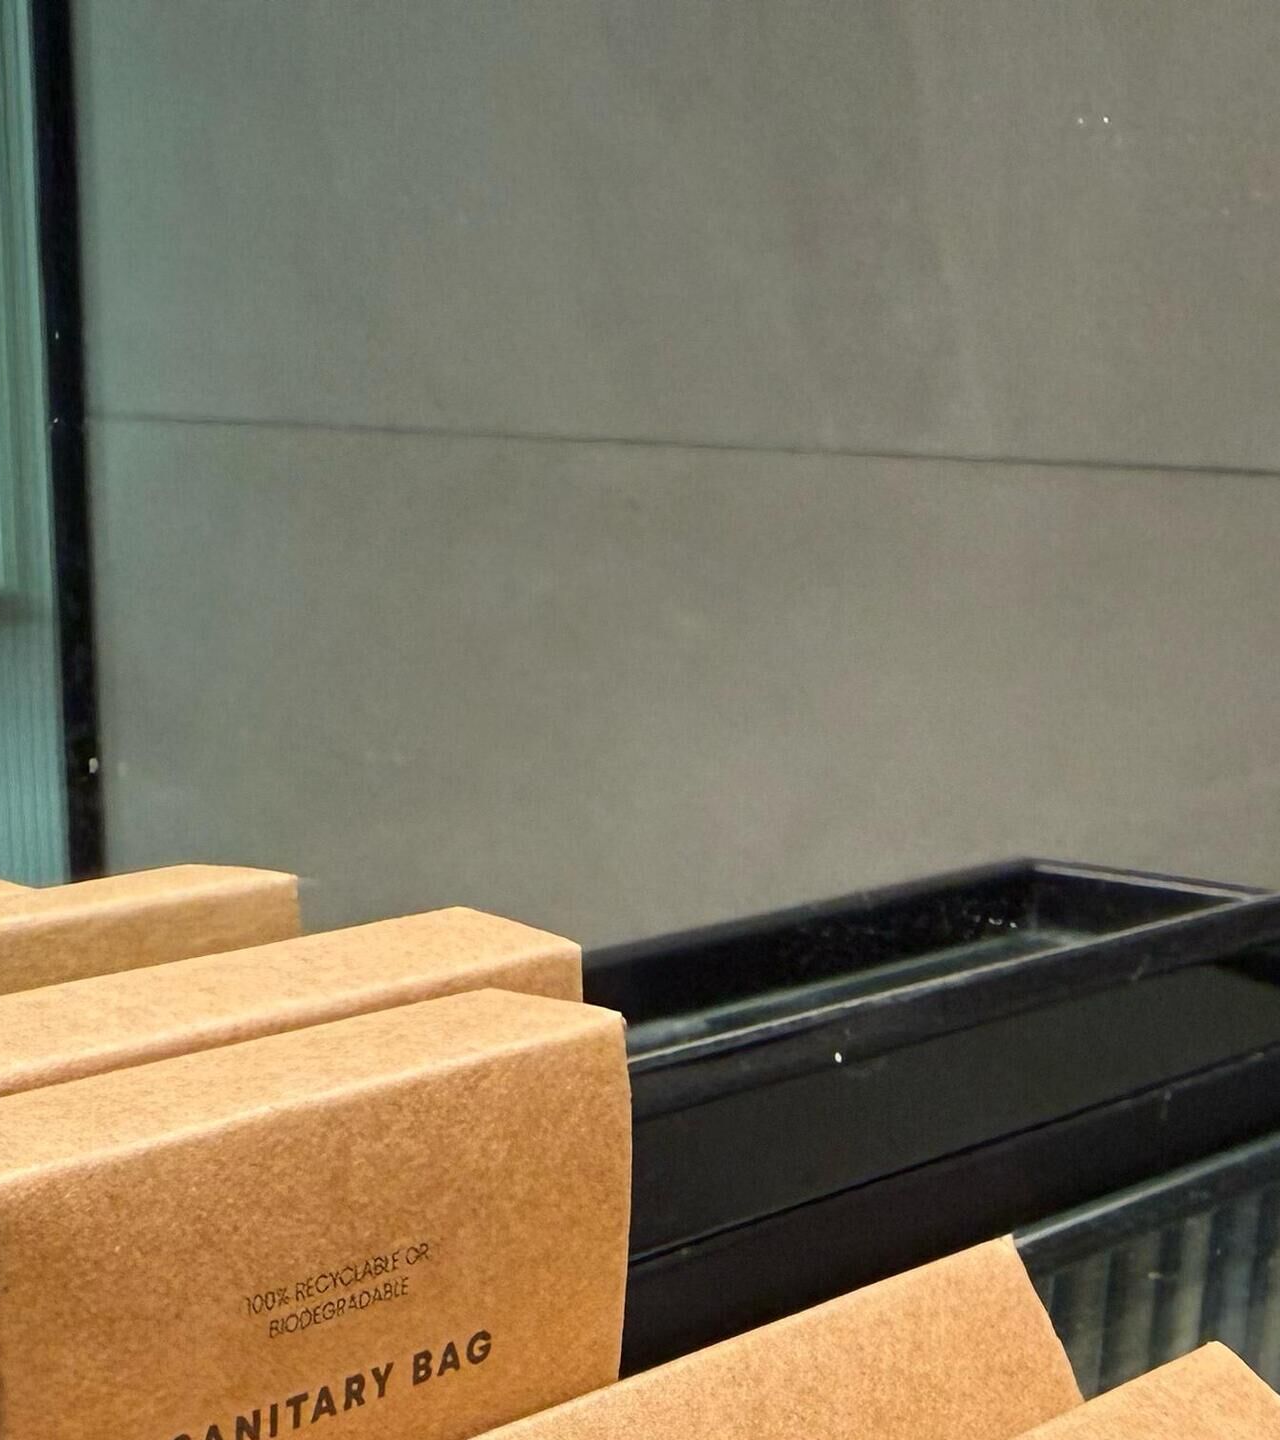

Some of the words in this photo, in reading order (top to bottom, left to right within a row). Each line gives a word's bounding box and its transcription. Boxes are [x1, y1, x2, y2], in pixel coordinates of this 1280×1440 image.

[246, 1286, 291, 1315] 100%
[295, 1251, 400, 1300] RECYCLABLE
[406, 1243, 430, 1265] OR
[269, 1277, 409, 1338] BIODEGRADABLE
[413, 1330, 492, 1386] BAG
